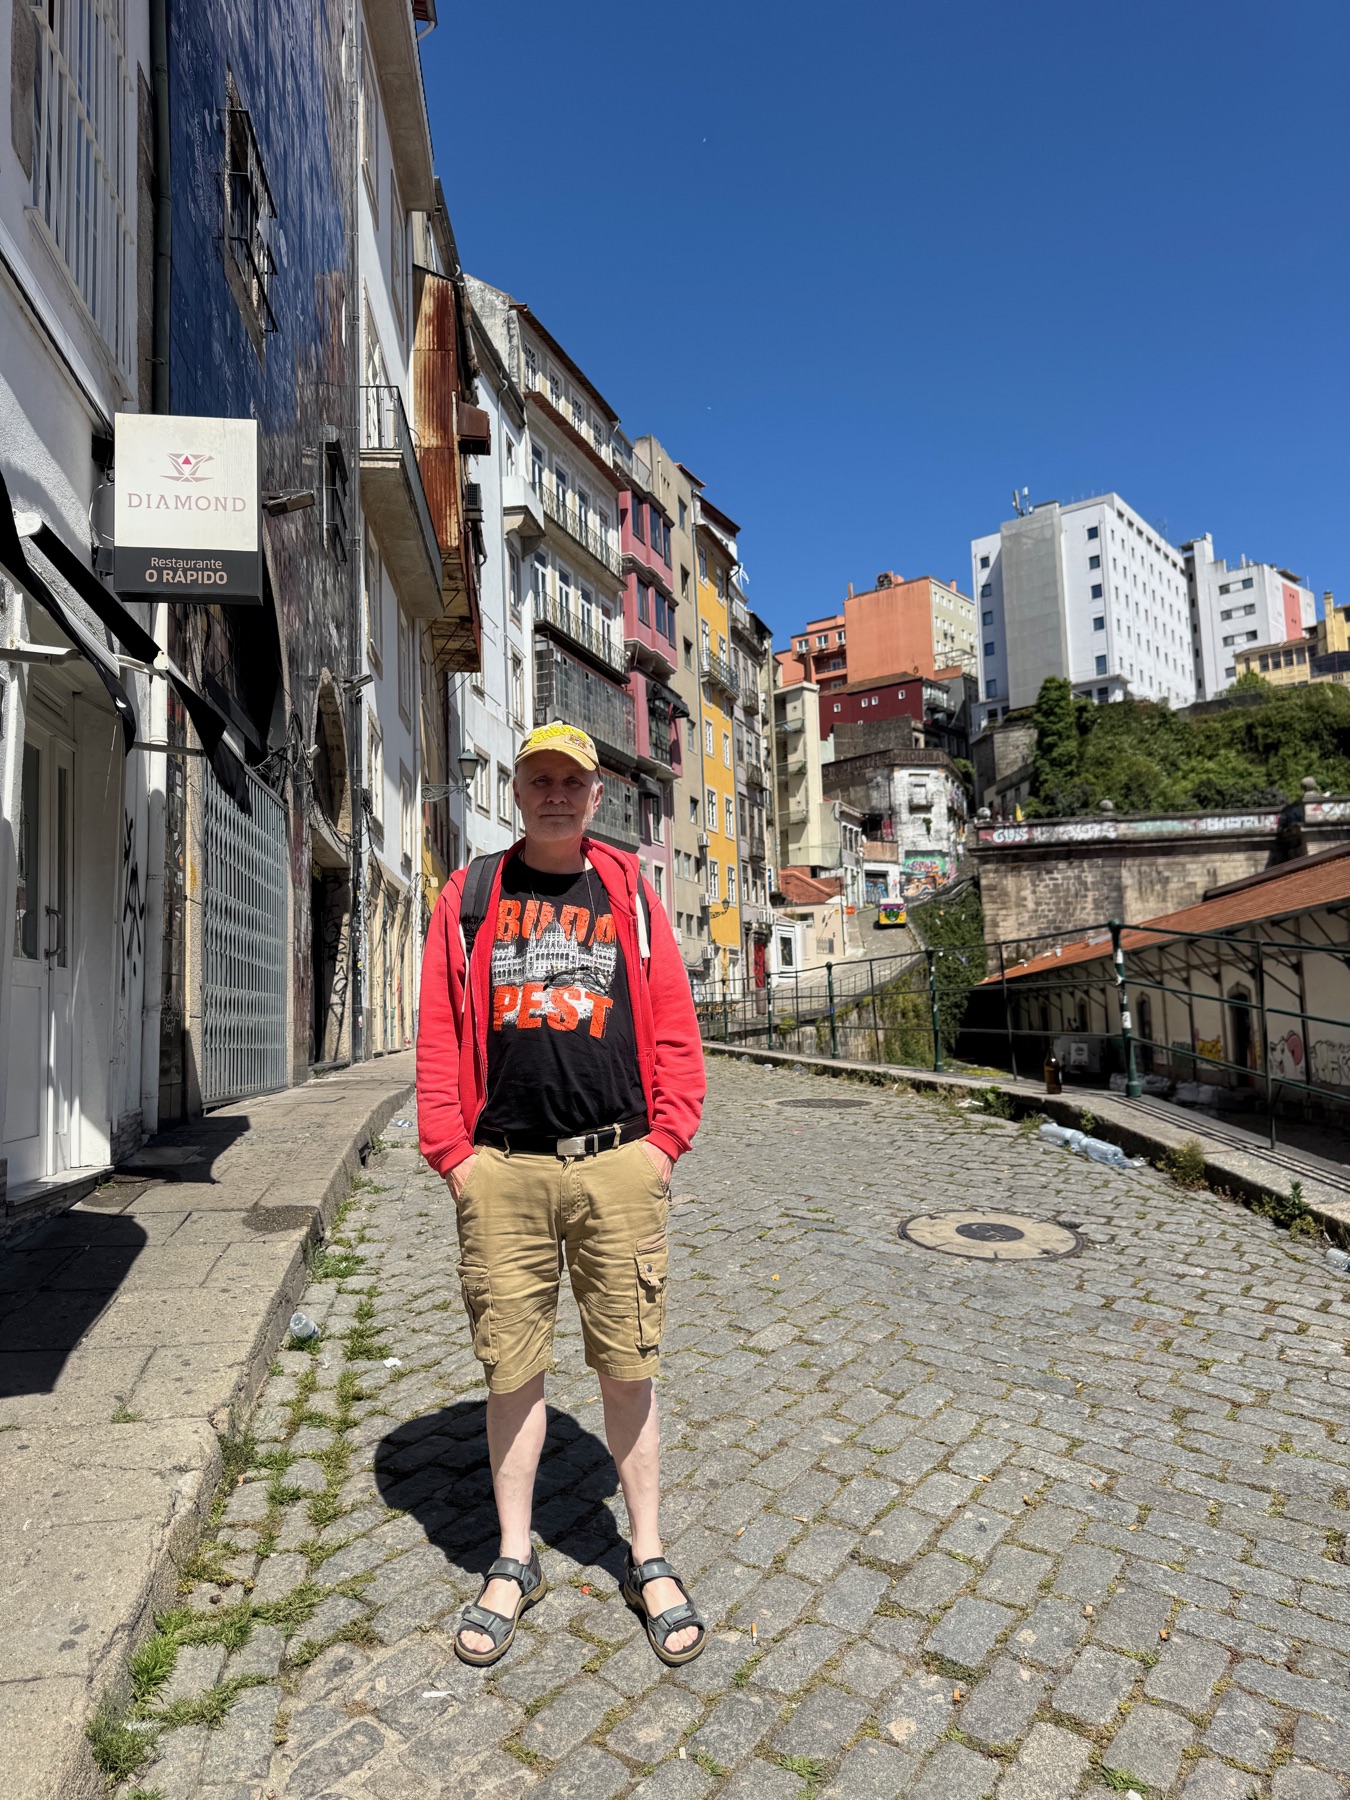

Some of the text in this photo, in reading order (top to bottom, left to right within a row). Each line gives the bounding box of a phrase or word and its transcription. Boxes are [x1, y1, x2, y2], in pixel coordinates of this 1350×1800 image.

[127, 492, 247, 512] DIAMOND
[150, 557, 223, 569] Restaurante
[145, 568, 228, 585] O RÁPIDO
[495, 898, 617, 947] BUDA
[492, 981, 614, 1039] PEST
